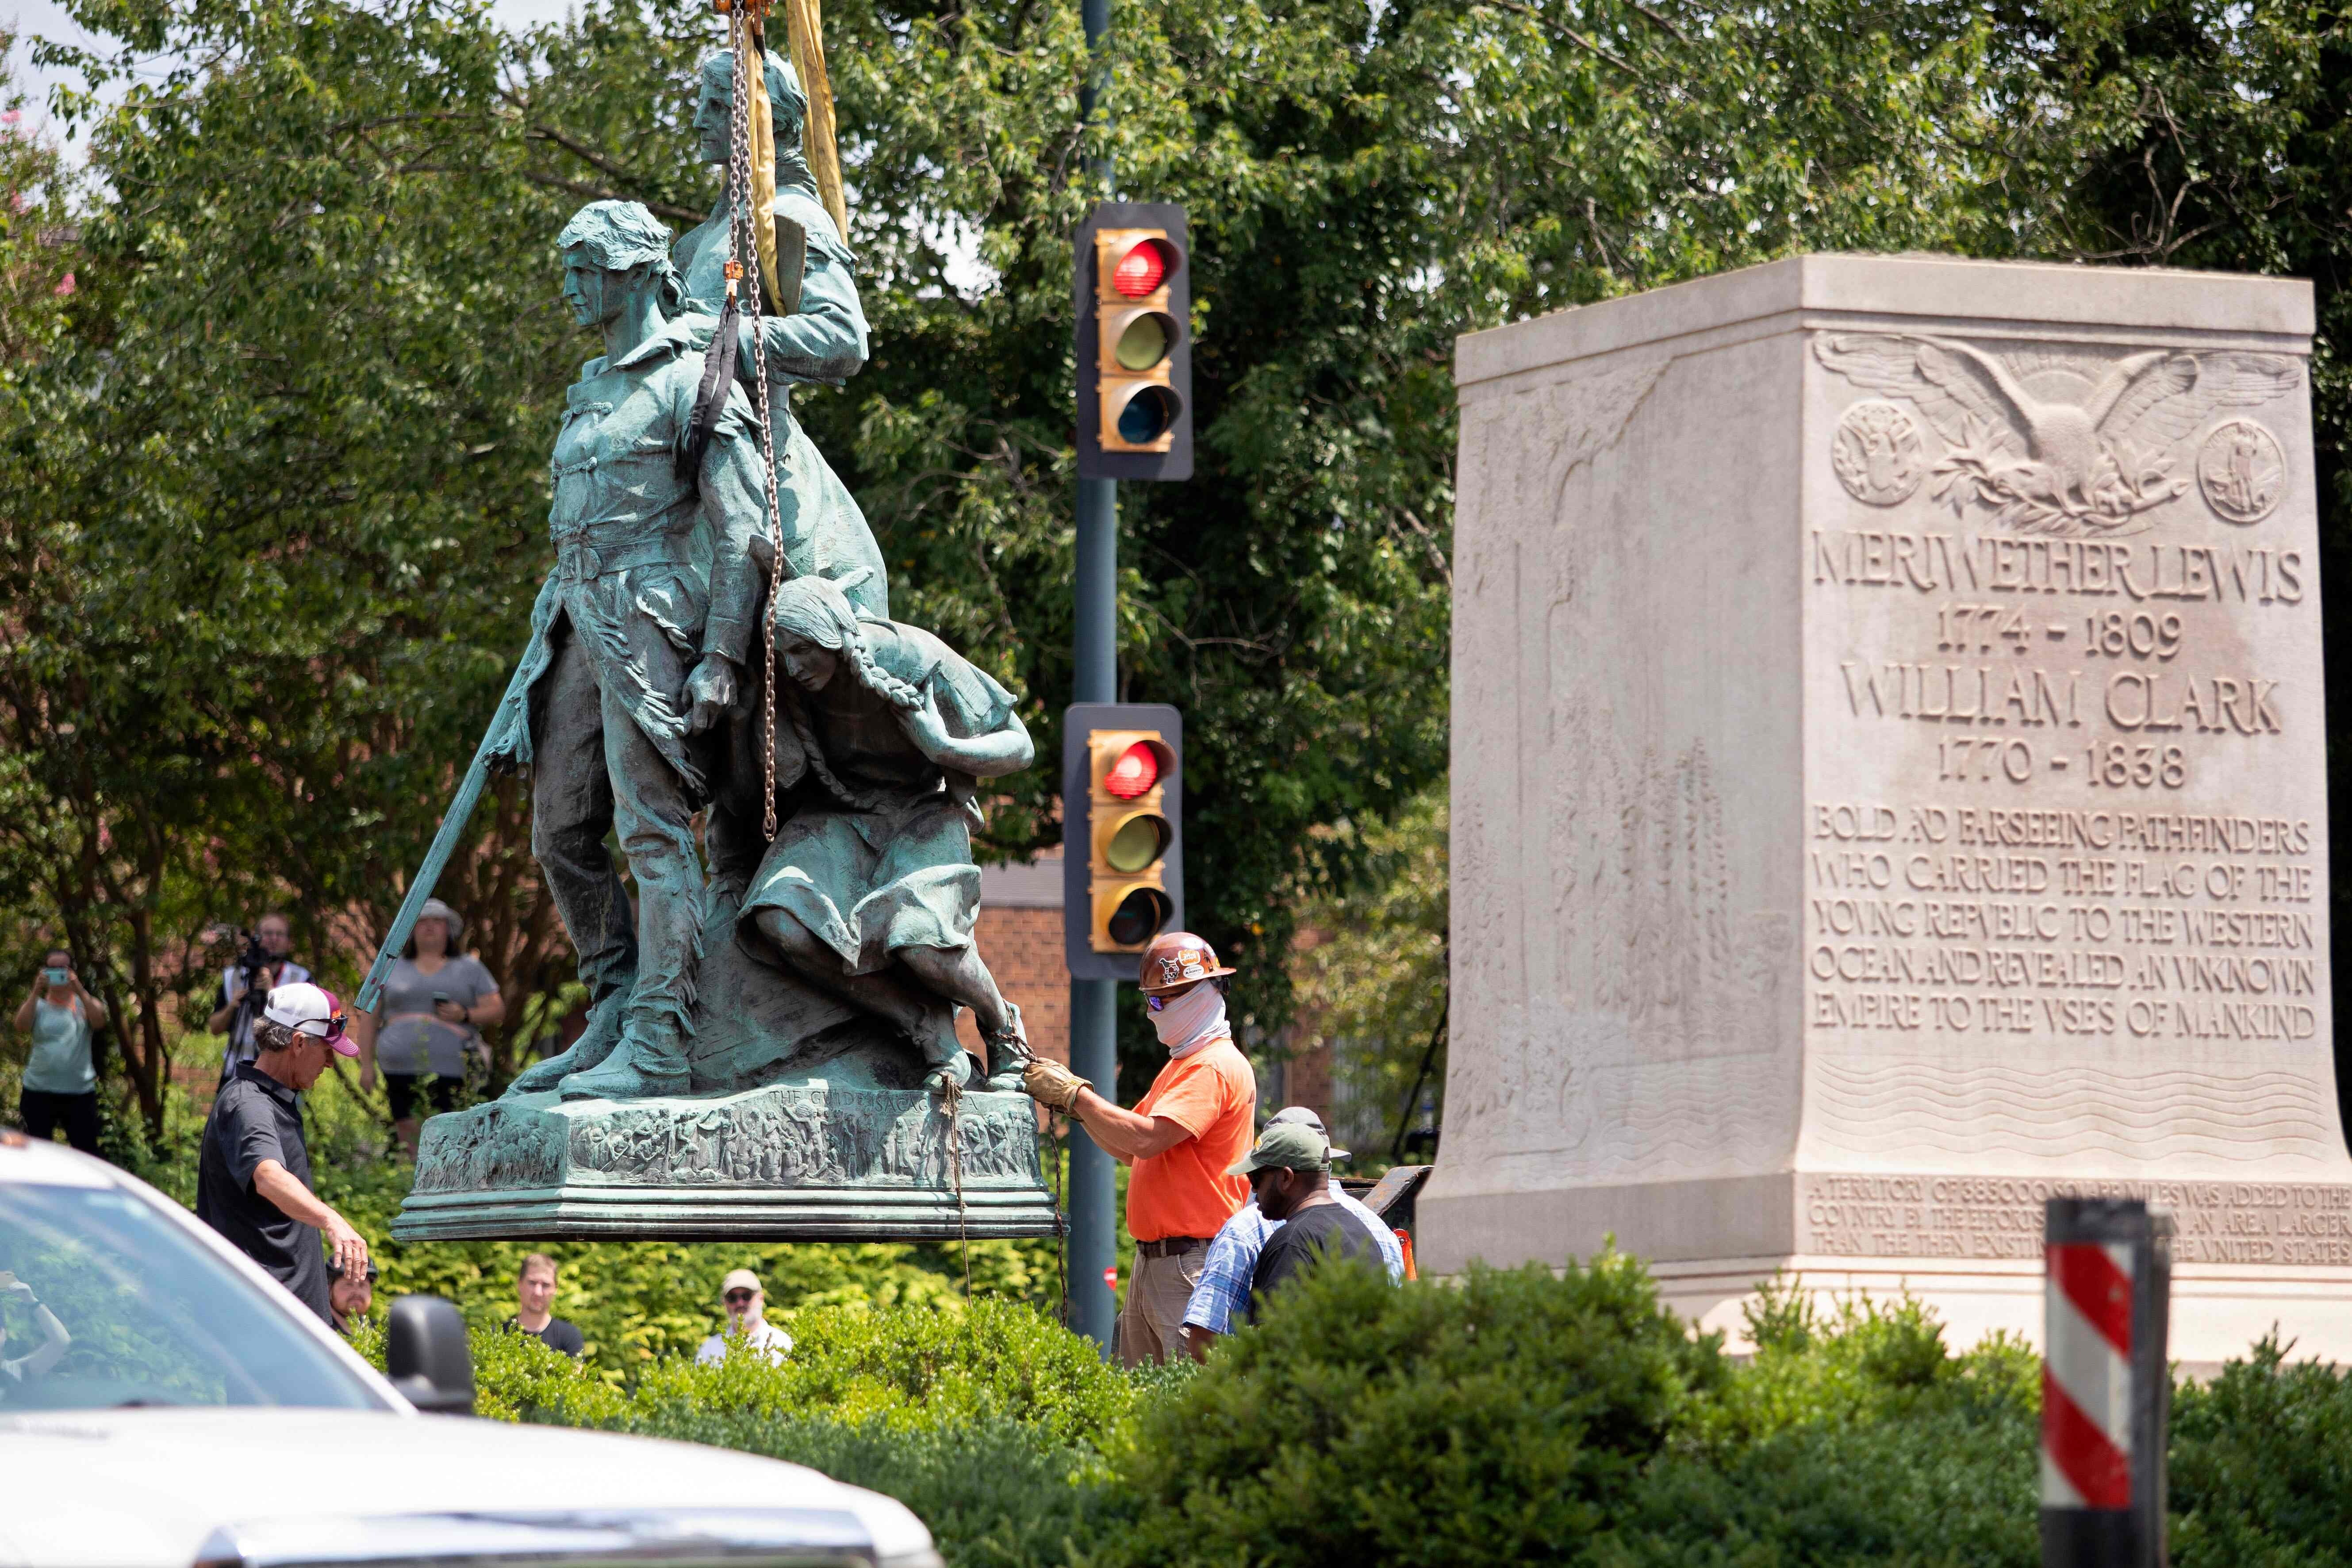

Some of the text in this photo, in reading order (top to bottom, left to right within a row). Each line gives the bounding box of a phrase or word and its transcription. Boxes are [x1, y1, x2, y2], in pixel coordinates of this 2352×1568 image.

[1812, 529, 2303, 603] MERIWETHER LEWIS
[1938, 602, 2030, 655] 1774
[2085, 609, 2181, 663] 1809
[1841, 662, 2281, 737] WILLIAM CLARK
[1938, 734, 2030, 785] 1770
[2087, 740, 2184, 789] 1838
[1814, 803, 1897, 841] BOLD
[1957, 806, 2113, 850] FARSEEING
[2118, 813, 2309, 855] PATHFINDERS
[1812, 850, 2312, 903] WHO CARRIED THE FLAG OF THE
[1812, 898, 2314, 949] YOVNG REPVBLIC TO THE WESTERN
[1811, 946, 2315, 996] OCEAN AND REVEALED AN VNKNOWN
[1813, 992, 2315, 1042] EMPIRE TO THE VSES OF MANKIND
[769, 1090, 801, 1105] THE
[1809, 1177, 1825, 1199] A
[1827, 1176, 1926, 1202] TERRITORY
[1933, 1177, 1958, 1203] OF
[2125, 1181, 2179, 1208] MILES
[2182, 1183, 2220, 1208] WAS
[2224, 1184, 2288, 1209] ADDED
[2291, 1185, 2316, 1209] TO
[2318, 1185, 2352, 1210] THE
[1811, 1228, 1862, 1252] THAN
[1872, 1231, 1910, 1254] THE
[1917, 1232, 1964, 1255] THEN
[2283, 1240, 2352, 1263] STATES
[1931, 1205, 1964, 1230] THE
[1967, 1207, 2045, 1232] EFFORTS
[2188, 1211, 2216, 1235] AN
[2220, 1211, 2270, 1235] AREA
[2276, 1212, 2352, 1237] LARGER
